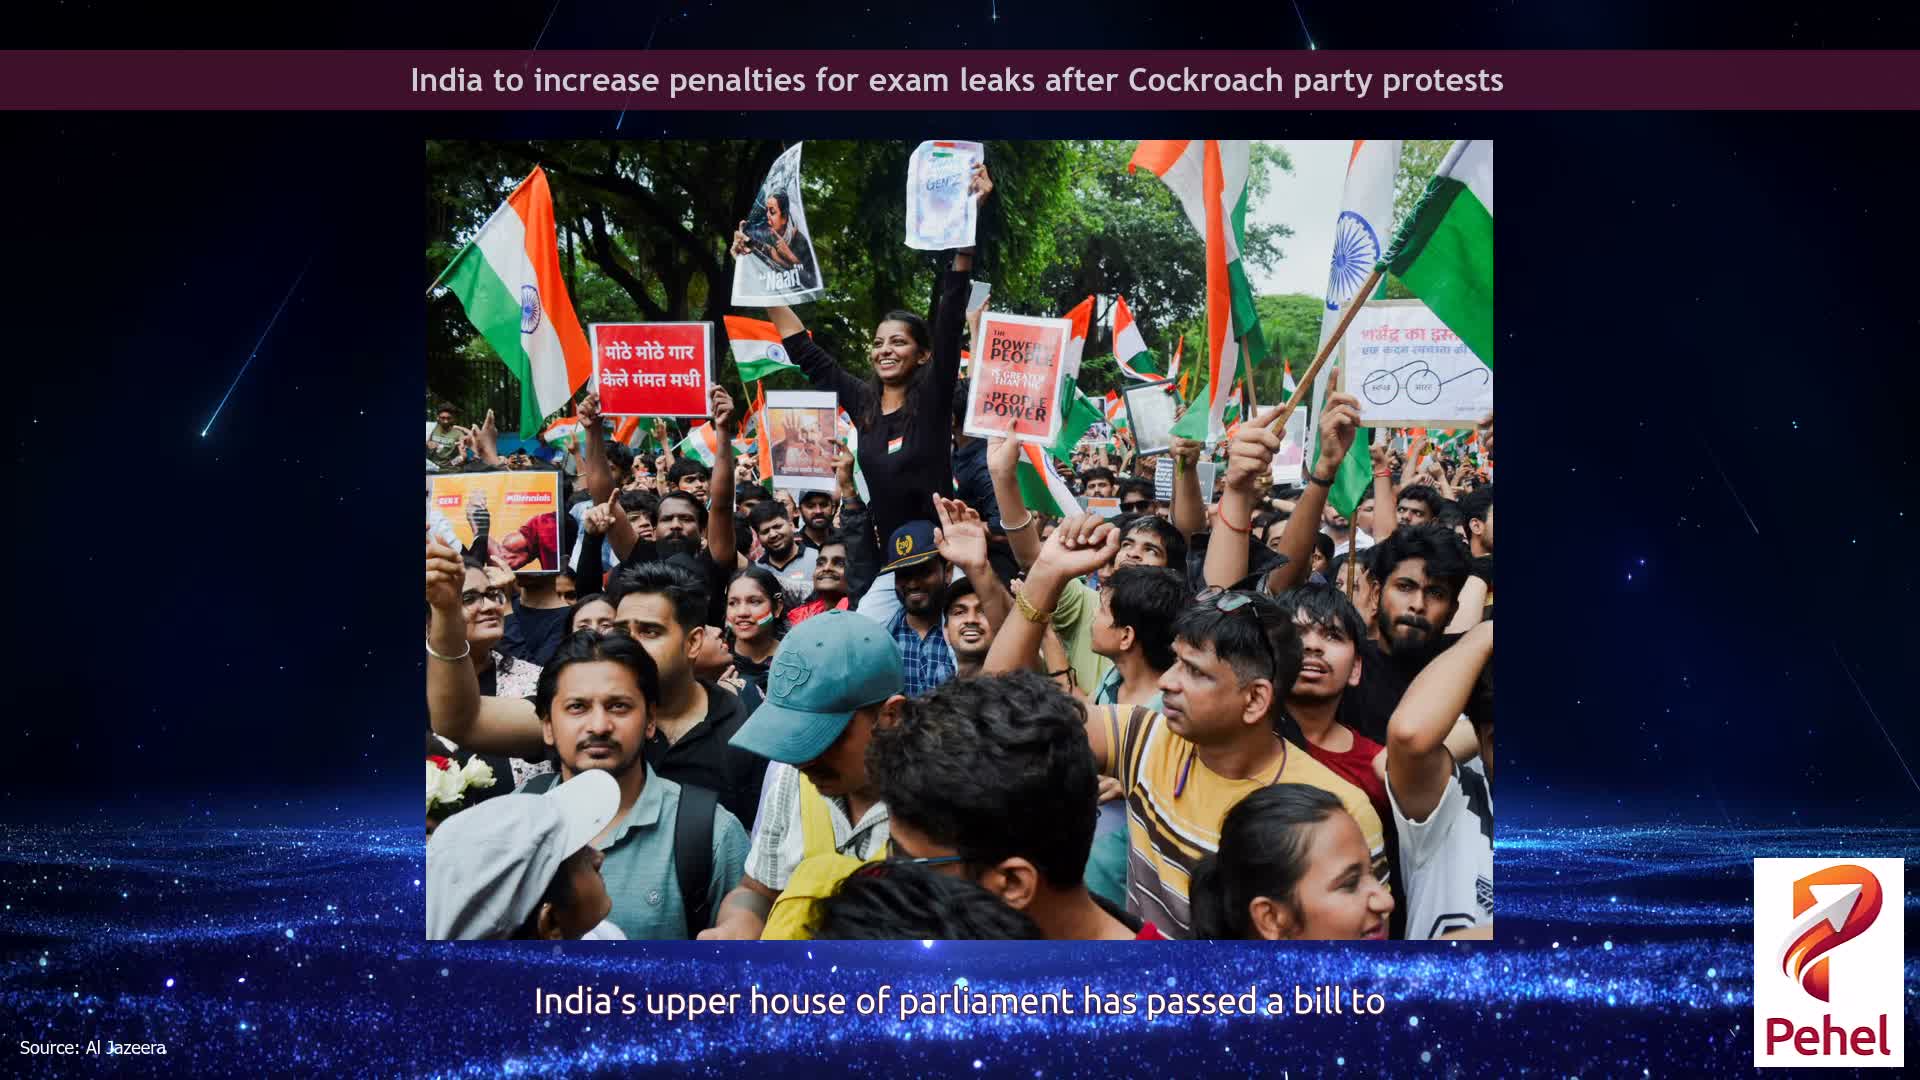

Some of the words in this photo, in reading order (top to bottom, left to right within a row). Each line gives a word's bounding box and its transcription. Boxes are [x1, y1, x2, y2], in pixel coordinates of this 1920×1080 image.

[605, 341, 632, 360] मोठे
[635, 341, 665, 360] मोठे
[668, 345, 695, 360] गार
[990, 348, 1055, 367] PEOPLE
[601, 368, 629, 387] केले
[632, 369, 667, 387] गंमत
[670, 368, 701, 387] मधी
[992, 391, 1048, 408] PEOPLE
[983, 401, 1047, 422] POWER
